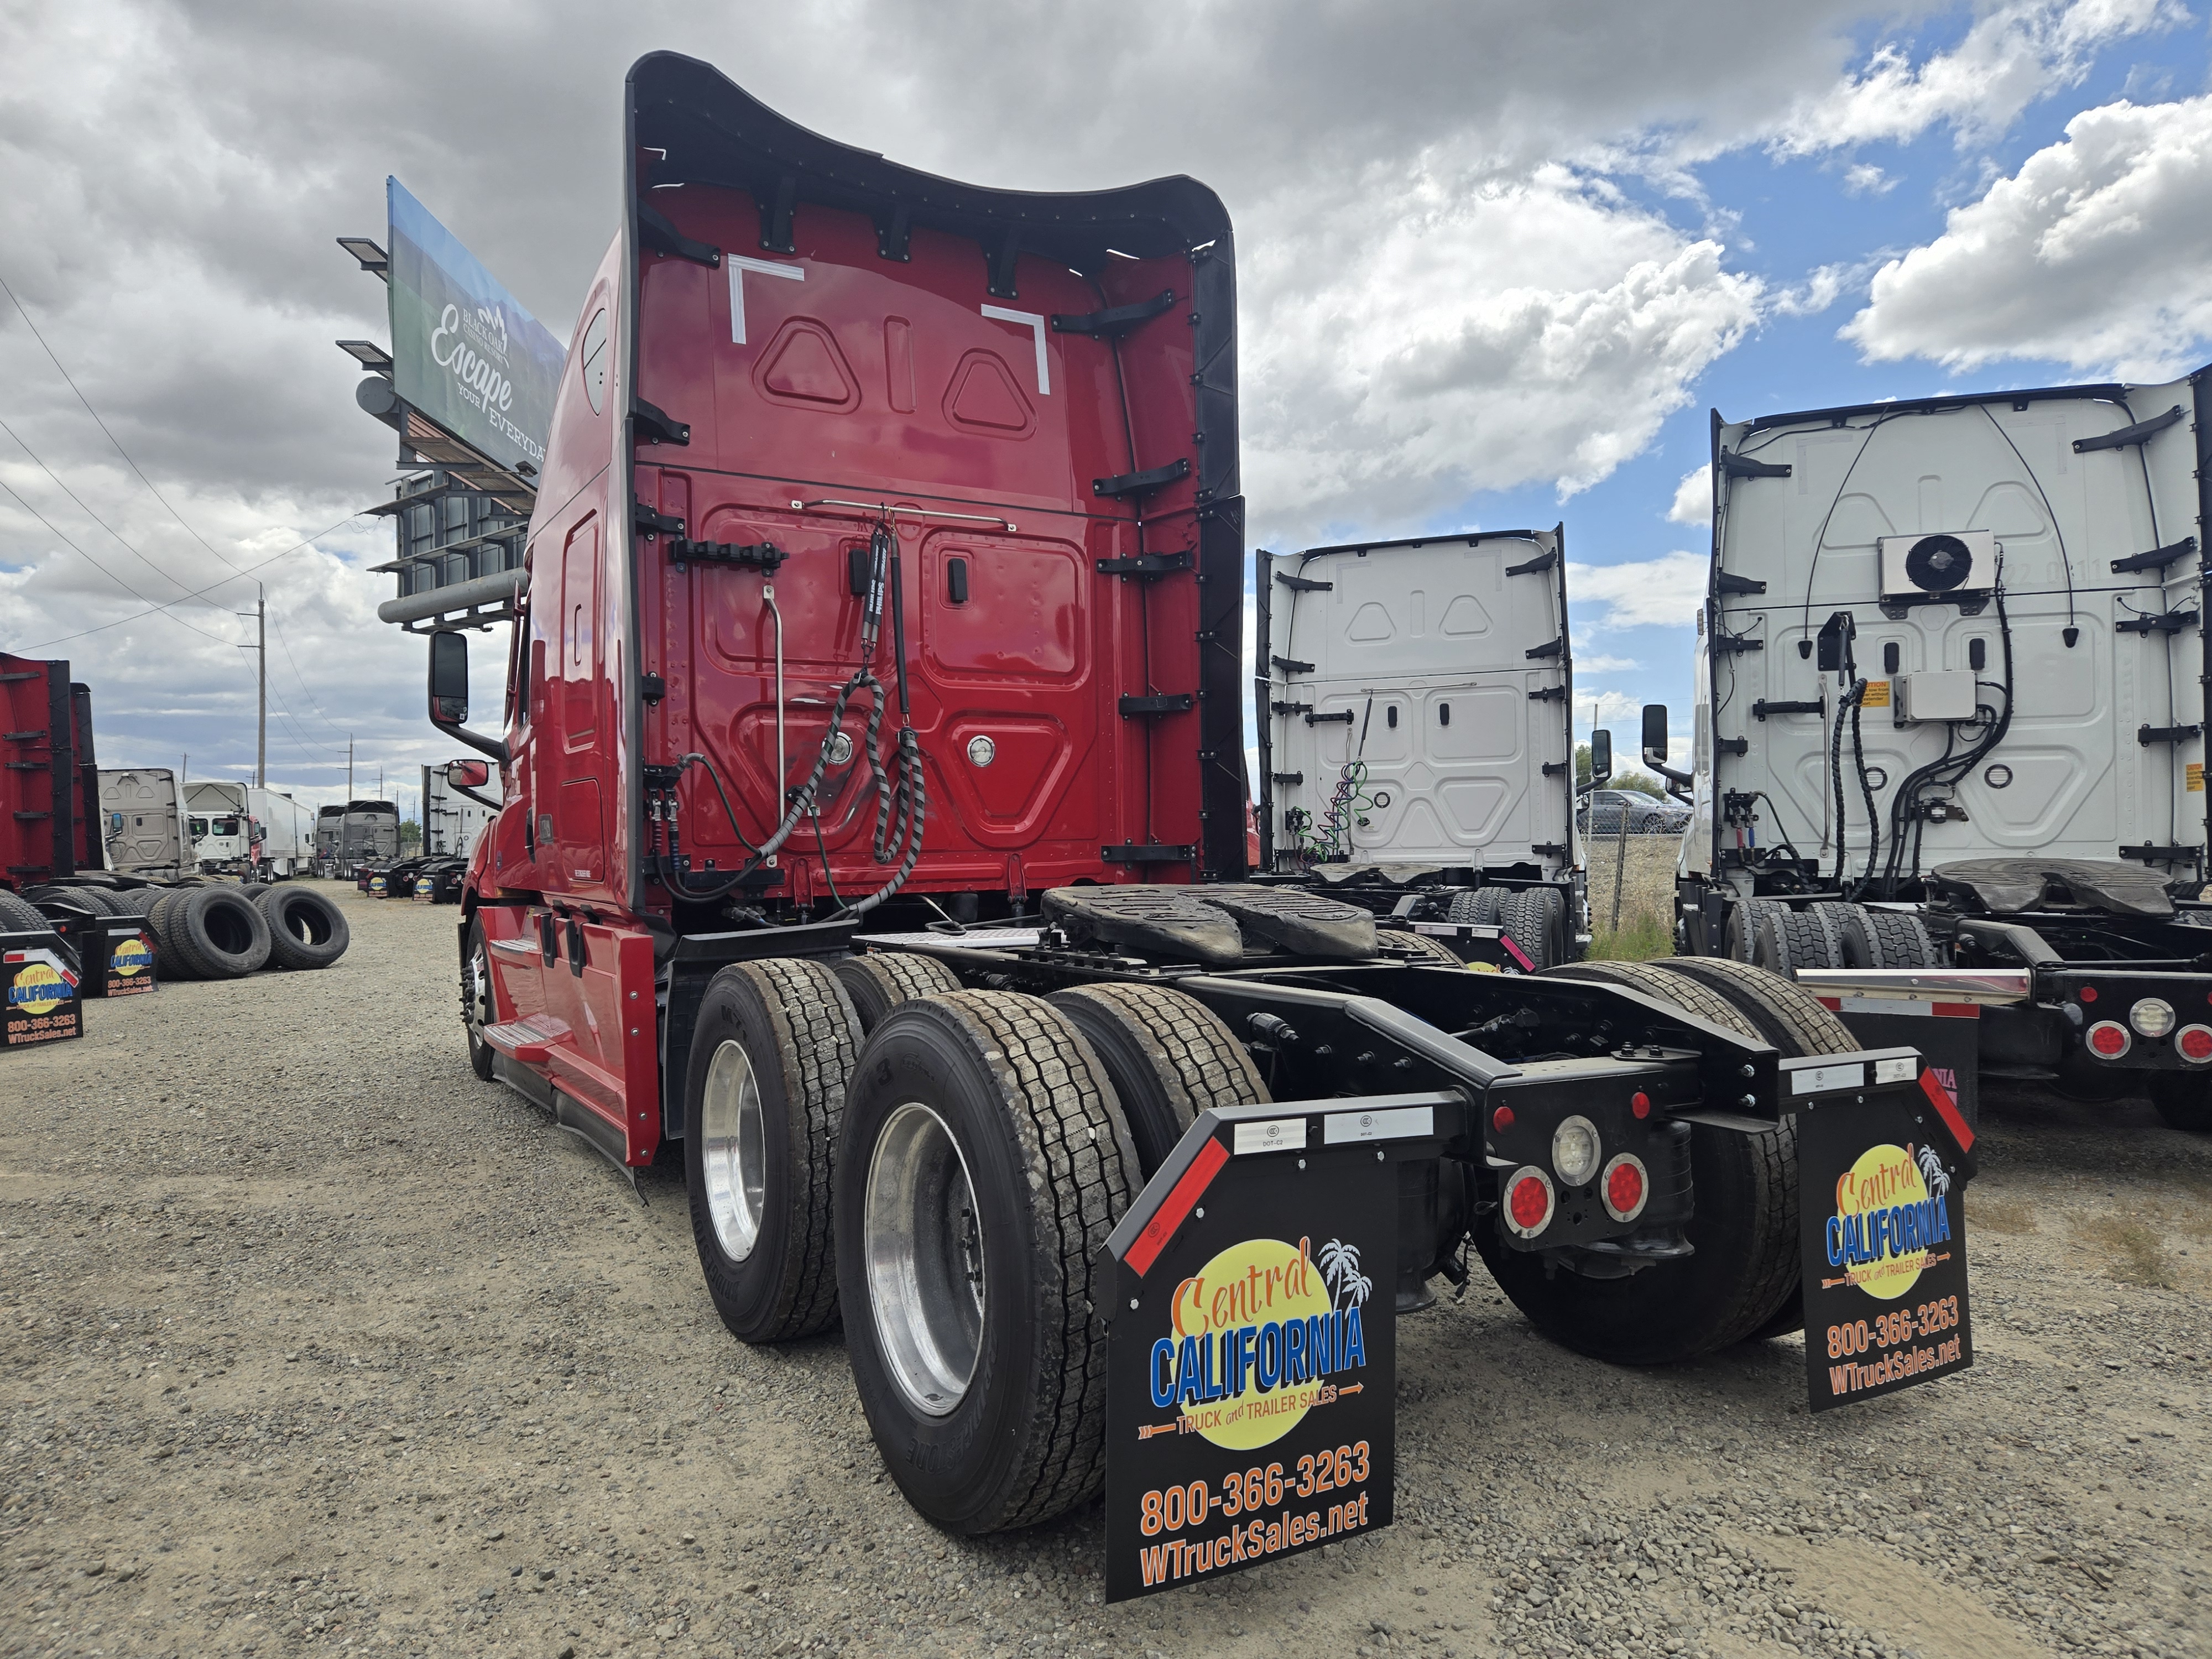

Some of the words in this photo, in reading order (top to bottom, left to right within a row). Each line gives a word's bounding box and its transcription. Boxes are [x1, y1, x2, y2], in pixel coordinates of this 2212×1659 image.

[463, 308, 487, 341] BLACK
[488, 332, 504, 353] OAK
[431, 304, 513, 413] Escape
[457, 382, 481, 409] YOUR
[489, 407, 546, 462] EVERYDA
[875, 582, 884, 615] PHILIPS
[110, 953, 153, 968] CALIFORNIA
[115, 940, 143, 956] Central
[8, 982, 73, 1004] CALIFORNIA
[13, 968, 54, 988] Central
[108, 976, 152, 988] 800-366-3263
[108, 985, 154, 997] WTruckSales.net
[8, 1013, 76, 1033] 800-366-3263
[8, 1026, 76, 1044] WTruckSales.net
[1836, 1142, 1917, 1218] Central
[1826, 1195, 1951, 1266] CALIFORNIA
[1171, 1235, 1313, 1341] Central
[1844, 1269, 1872, 1287] TRUCK
[1874, 1262, 1885, 1281] and
[1886, 1260, 1914, 1277] TRAILER
[1916, 1253, 1937, 1269] SALES
[1827, 1295, 1959, 1359] 800-366-3263
[1150, 1306, 1366, 1408] CALIFORNIA
[1829, 1333, 1961, 1395] WTruckSales.net
[1177, 1410, 1222, 1434] TRUCK
[1225, 1399, 1244, 1426] and
[1246, 1394, 1297, 1420] TRAILER
[1300, 1385, 1337, 1409] SALES
[1140, 1440, 1370, 1536] 800-366-3263
[1140, 1490, 1369, 1587] WTruckSales.net
